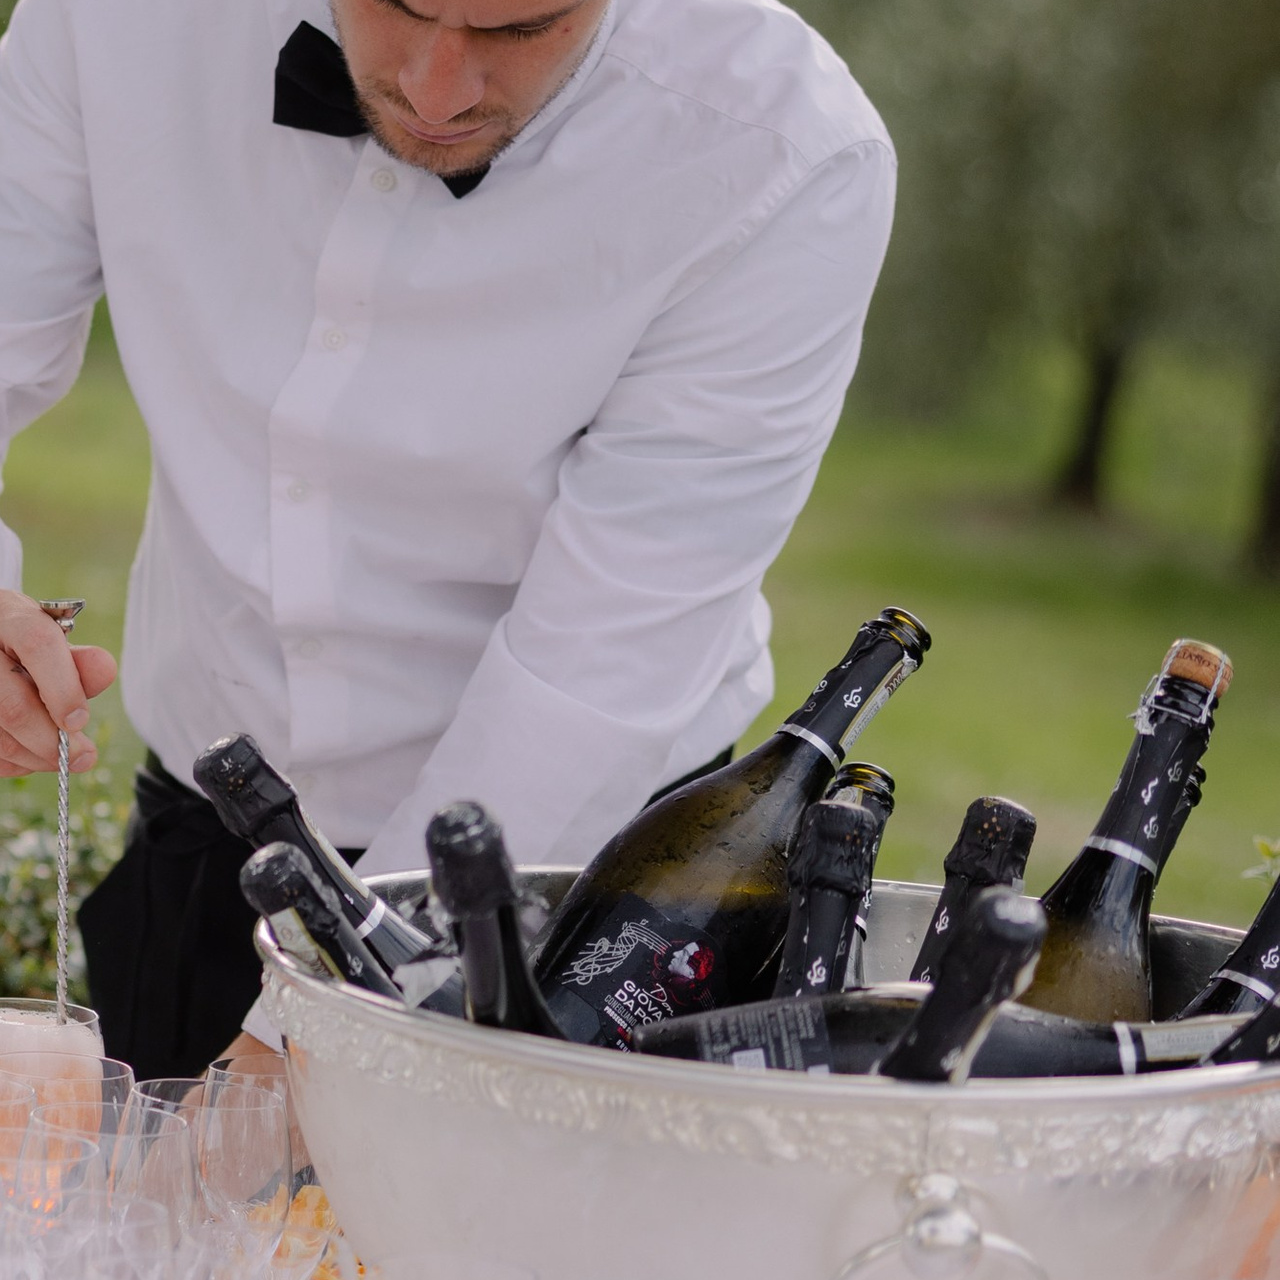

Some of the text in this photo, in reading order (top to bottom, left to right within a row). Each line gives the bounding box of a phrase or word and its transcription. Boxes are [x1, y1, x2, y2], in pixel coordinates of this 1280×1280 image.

[604, 994, 637, 1026] CONEGLIANO
[614, 988, 635, 1011] DA
[623, 980, 666, 1022] GIOVA
[642, 983, 674, 1016] Don
[603, 1005, 628, 1029] PROSECCO
